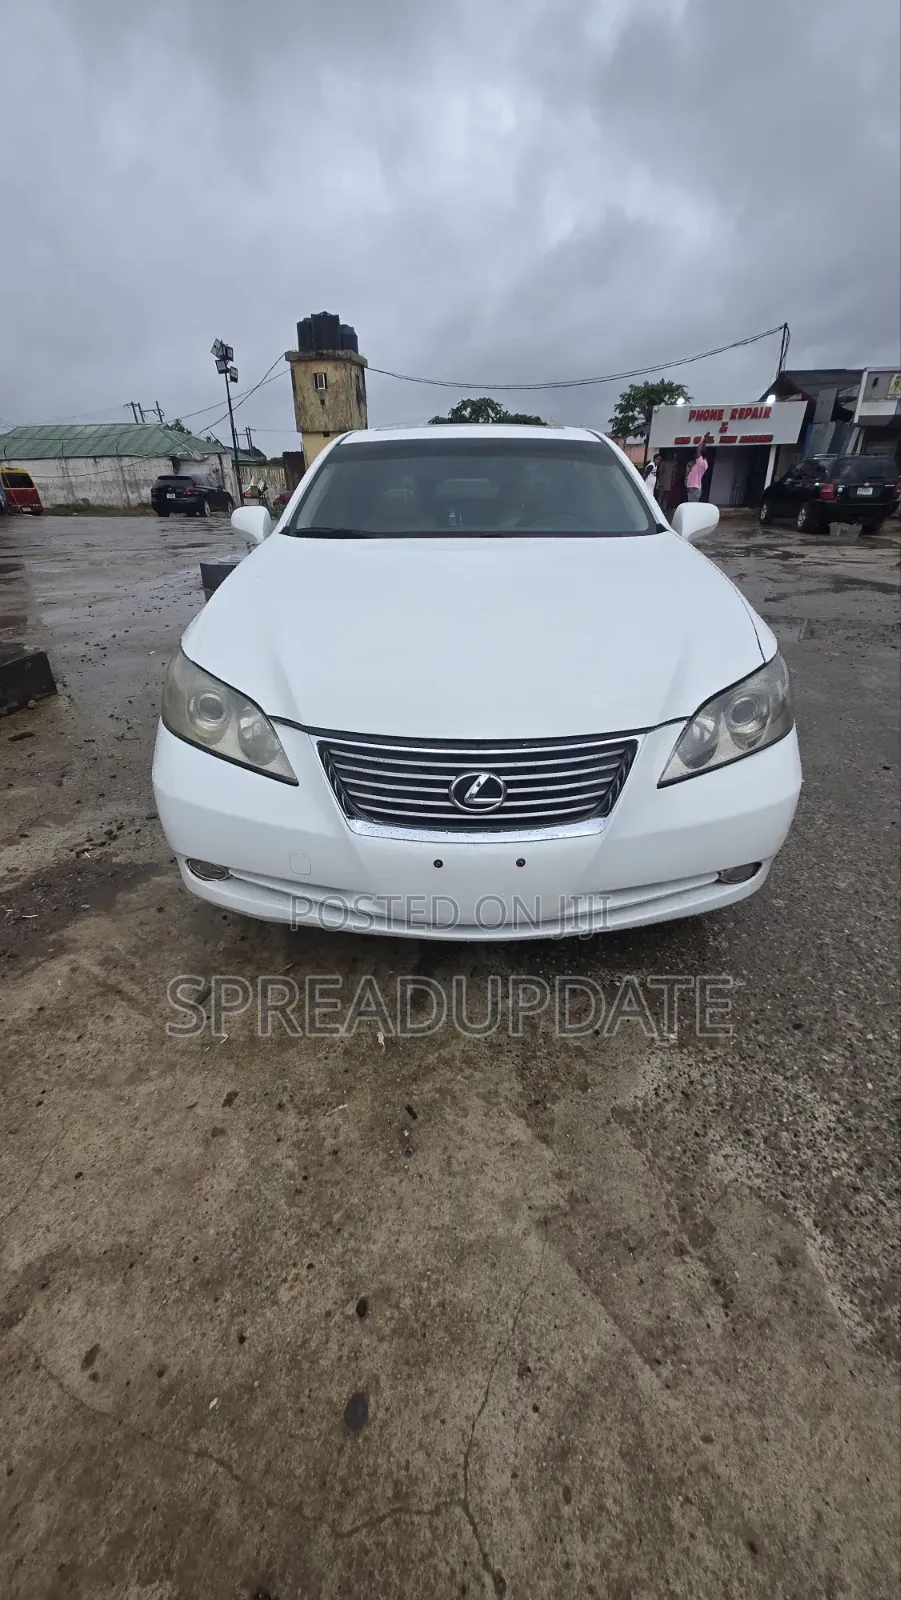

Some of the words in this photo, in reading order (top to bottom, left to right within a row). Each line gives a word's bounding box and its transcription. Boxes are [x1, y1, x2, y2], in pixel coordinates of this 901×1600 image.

[688, 409, 725, 422] PHONE
[729, 406, 773, 421] REPAIR
[719, 421, 729, 434] &
